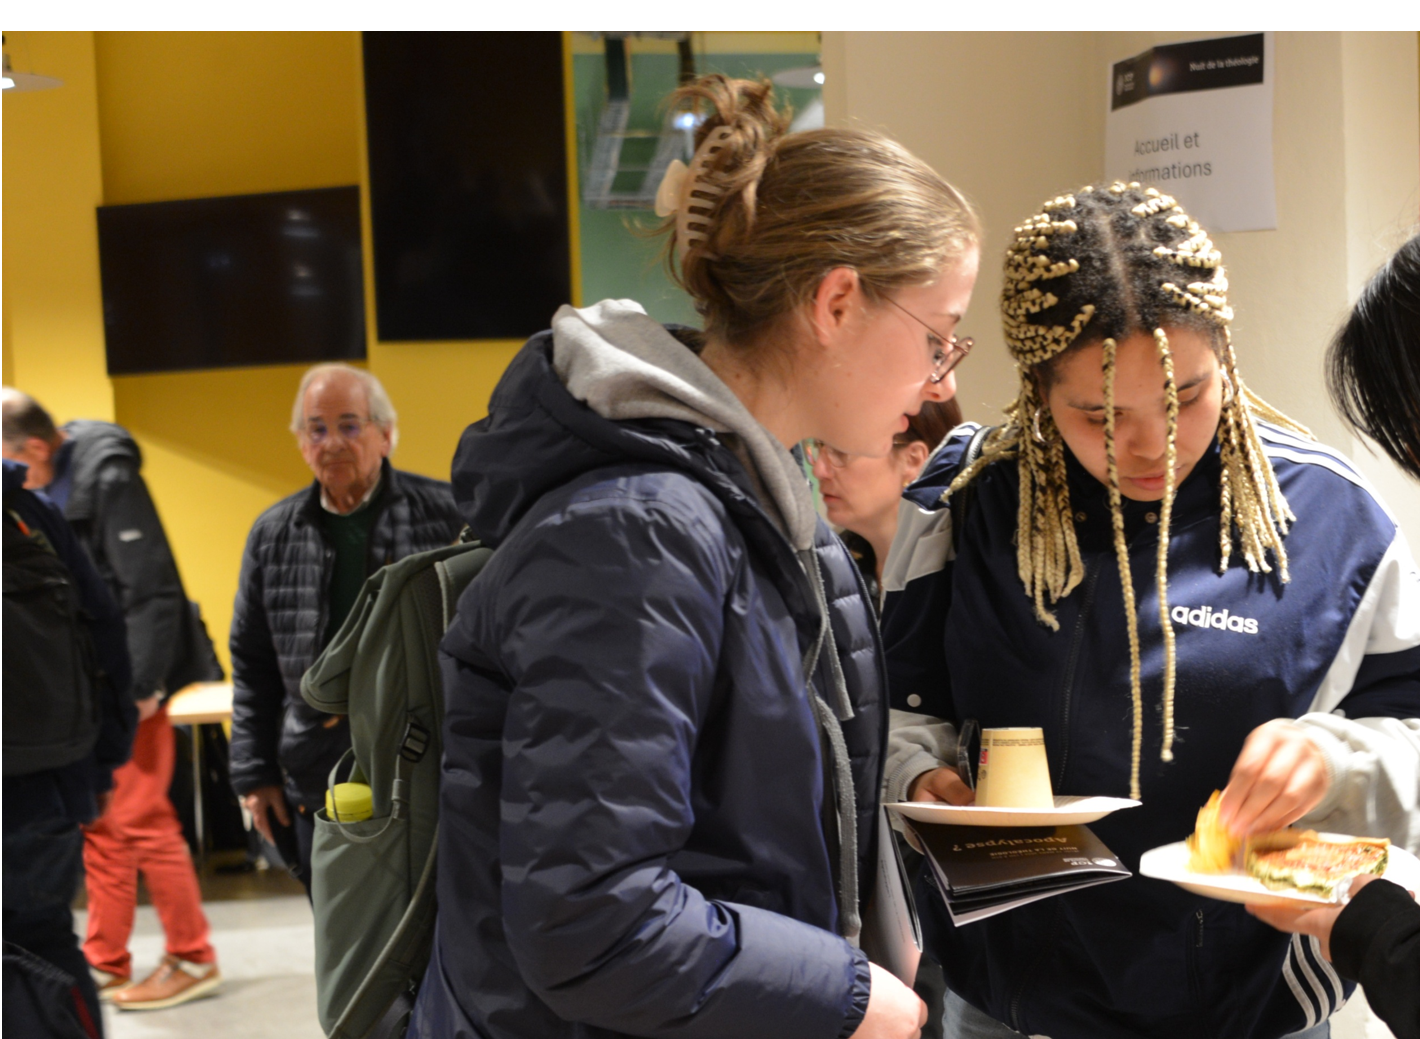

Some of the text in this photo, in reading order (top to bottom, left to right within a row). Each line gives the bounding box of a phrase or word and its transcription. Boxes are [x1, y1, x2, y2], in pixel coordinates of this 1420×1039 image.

[1206, 61, 1216, 71] de
[1217, 60, 1225, 69] la
[1134, 131, 1200, 157] Accueil et
[1171, 605, 1259, 635] adidas
[965, 837, 1068, 850] Apocalypse
